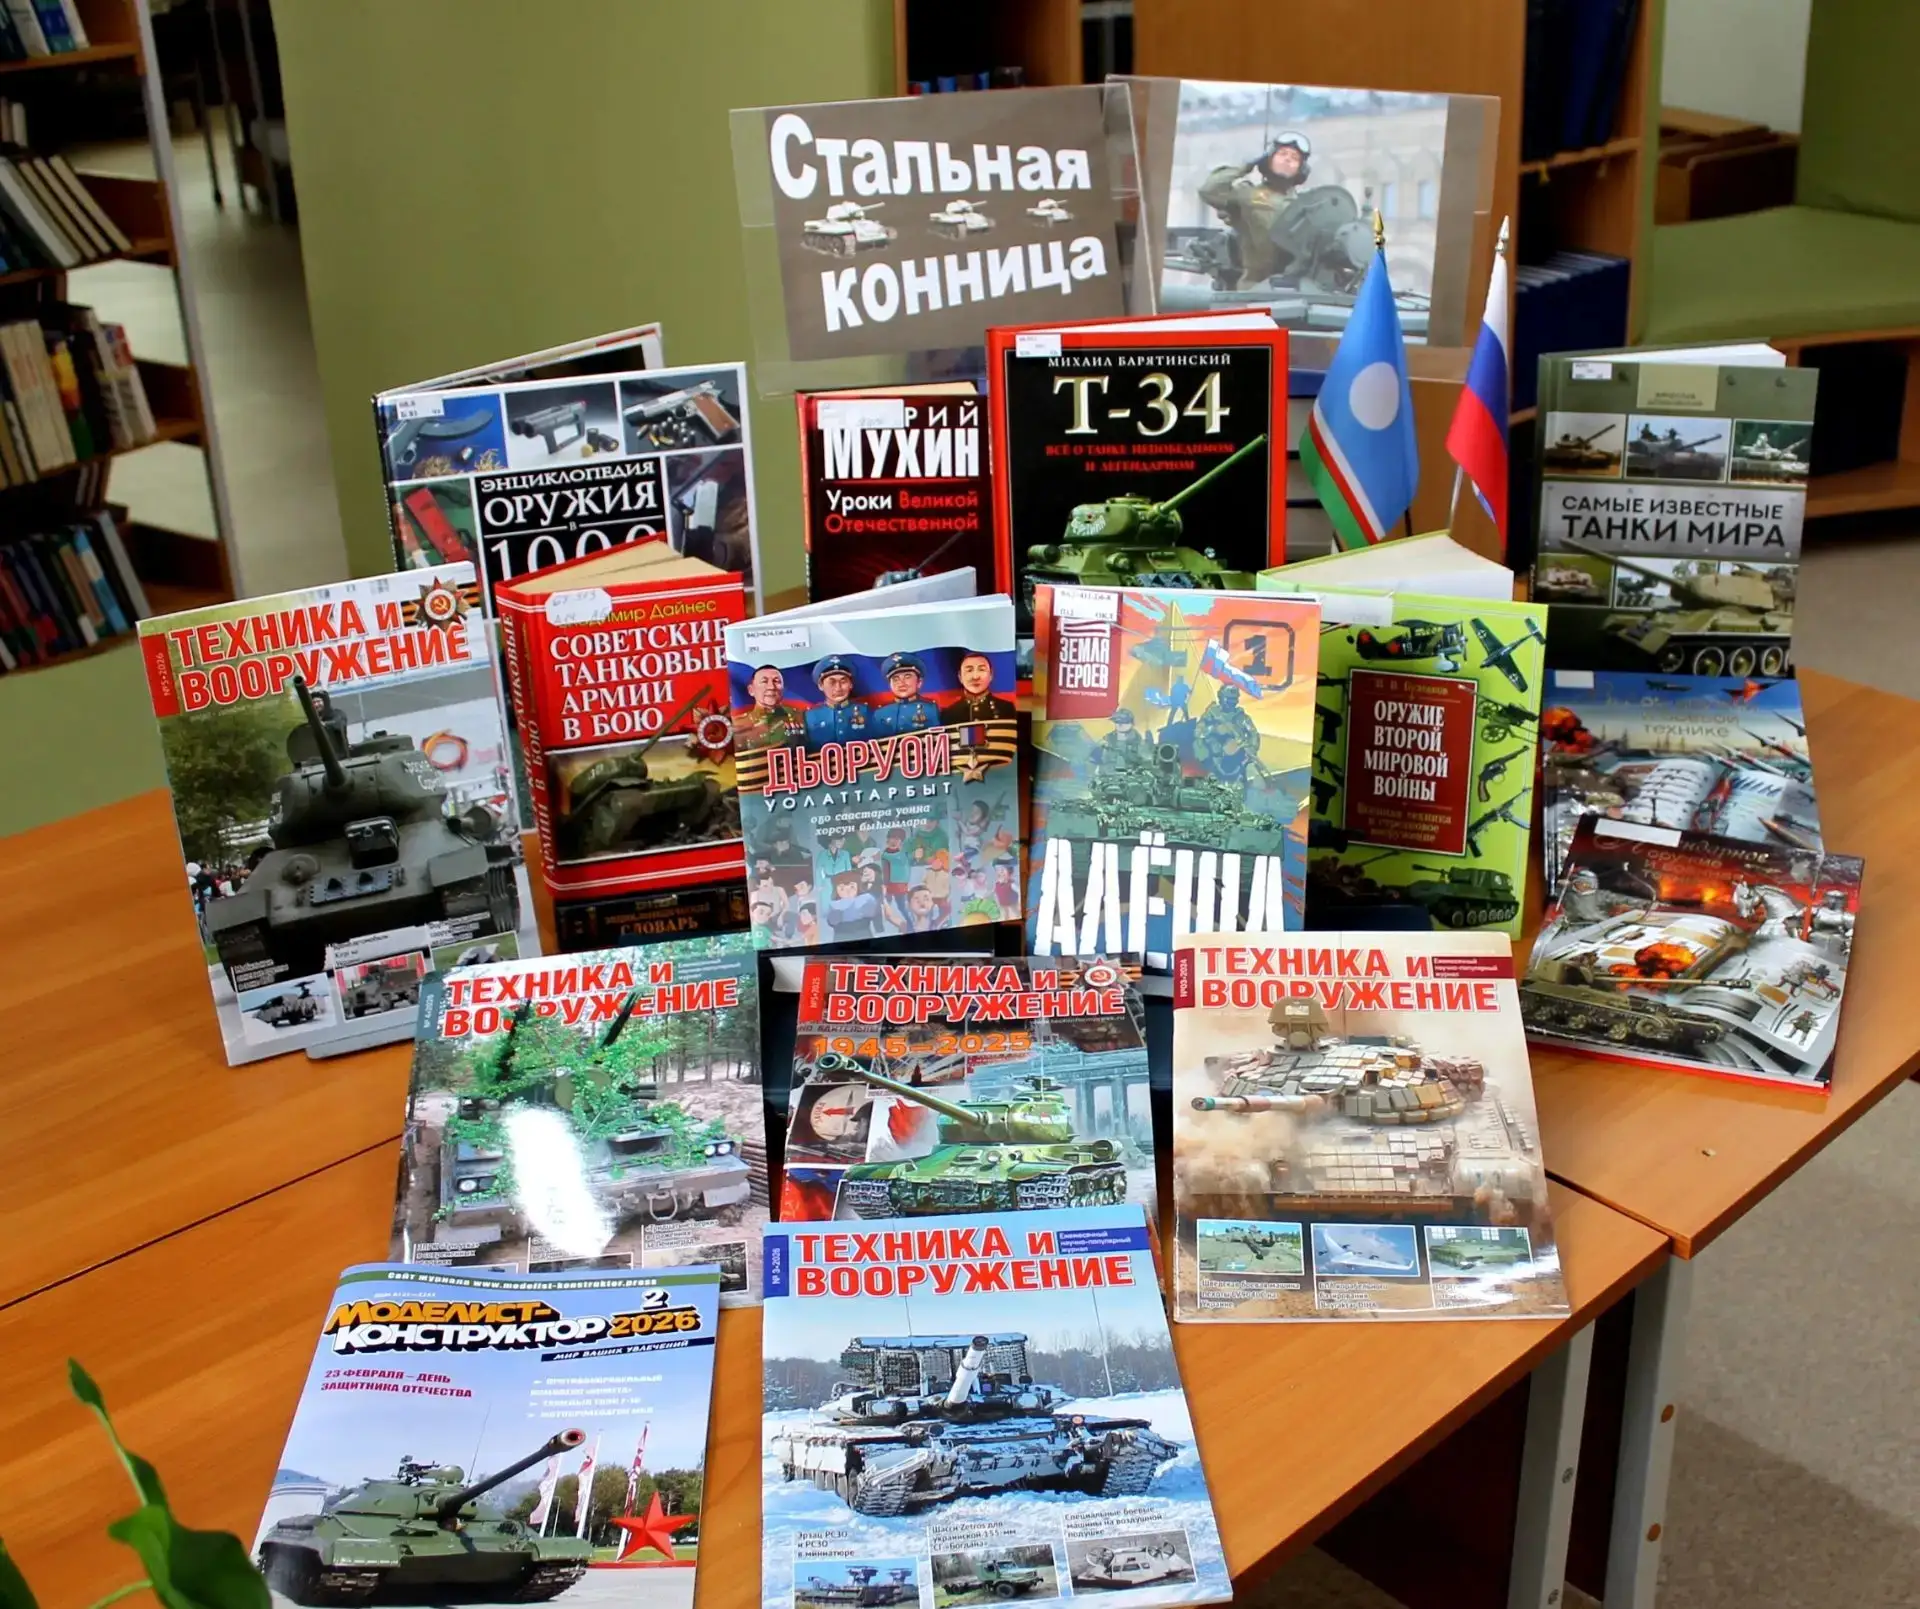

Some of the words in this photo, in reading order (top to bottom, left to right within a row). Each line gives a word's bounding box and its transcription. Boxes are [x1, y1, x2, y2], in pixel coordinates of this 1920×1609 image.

[769, 113, 1091, 199] Стальная
[821, 233, 1107, 331] конница
[1048, 356, 1113, 367] МИХАИЛ
[1118, 353, 1231, 366] БАРЯТИНСКИЙ
[904, 400, 979, 428] РИЙ
[1053, 371, 1231, 436] Т-34
[481, 460, 656, 494] ЭНЦИКЛОПЕДИЯ
[484, 480, 658, 528] ОРУЖИЯ
[826, 489, 892, 517] Уроки
[900, 490, 978, 509] Великой
[1562, 495, 1643, 514] САМЫЕ
[1650, 498, 1783, 520] ИЗВЕСТНЫЕ
[825, 512, 978, 533] Отечественной
[1561, 514, 1677, 542] ТАНКИ
[1687, 520, 1785, 548] МИРА
[650, 600, 717, 619] Дайнес
[170, 600, 371, 668] ТЕХНИКА
[550, 617, 730, 661] СОВЕТСКИЕ
[1059, 637, 1110, 664] ЗЕМЛЯ
[179, 623, 472, 713] ВООРУЖЕНИЕ
[555, 645, 729, 689] ТАНКОВЫЕ
[1243, 634, 1272, 677] 1
[1058, 662, 1109, 689] ГЕРОЕВ
[561, 680, 675, 716] АРМИИ
[1374, 699, 1445, 728] ОРУЖИЕ
[562, 717, 581, 742] В
[593, 707, 664, 738] БОЮ
[1374, 725, 1442, 752] ВТОРОЙ
[763, 726, 950, 798] ДЬОРУОЙ
[1364, 749, 1449, 779] МИРОВОЙ
[764, 780, 953, 813] УОЛАТТАРБЫТ
[1373, 774, 1437, 802] ВОЙНЫ
[829, 962, 1023, 993] ТЕХНИКА
[1201, 947, 1393, 978] ТЕХНИКА
[448, 961, 635, 1006] ТЕХНИКА
[827, 986, 1126, 1025] ВООРУЖЕНИЕ
[794, 1226, 1013, 1264] ТЕХНИКА
[795, 1255, 1136, 1297] ВООРУЖЕНИЕ
[642, 1287, 668, 1311] 2
[332, 1316, 607, 1353] КОНСТРУКТОР
[609, 1311, 698, 1335] 2026
[321, 1381, 399, 1394] ЗАЩИТНИКА
[401, 1385, 473, 1399] ОТЕЧЕСТВА
[325, 1370, 341, 1380] 23
[343, 1369, 404, 1381] ФЕВРАЛЯ
[416, 1373, 451, 1384] ДЕНЬ
